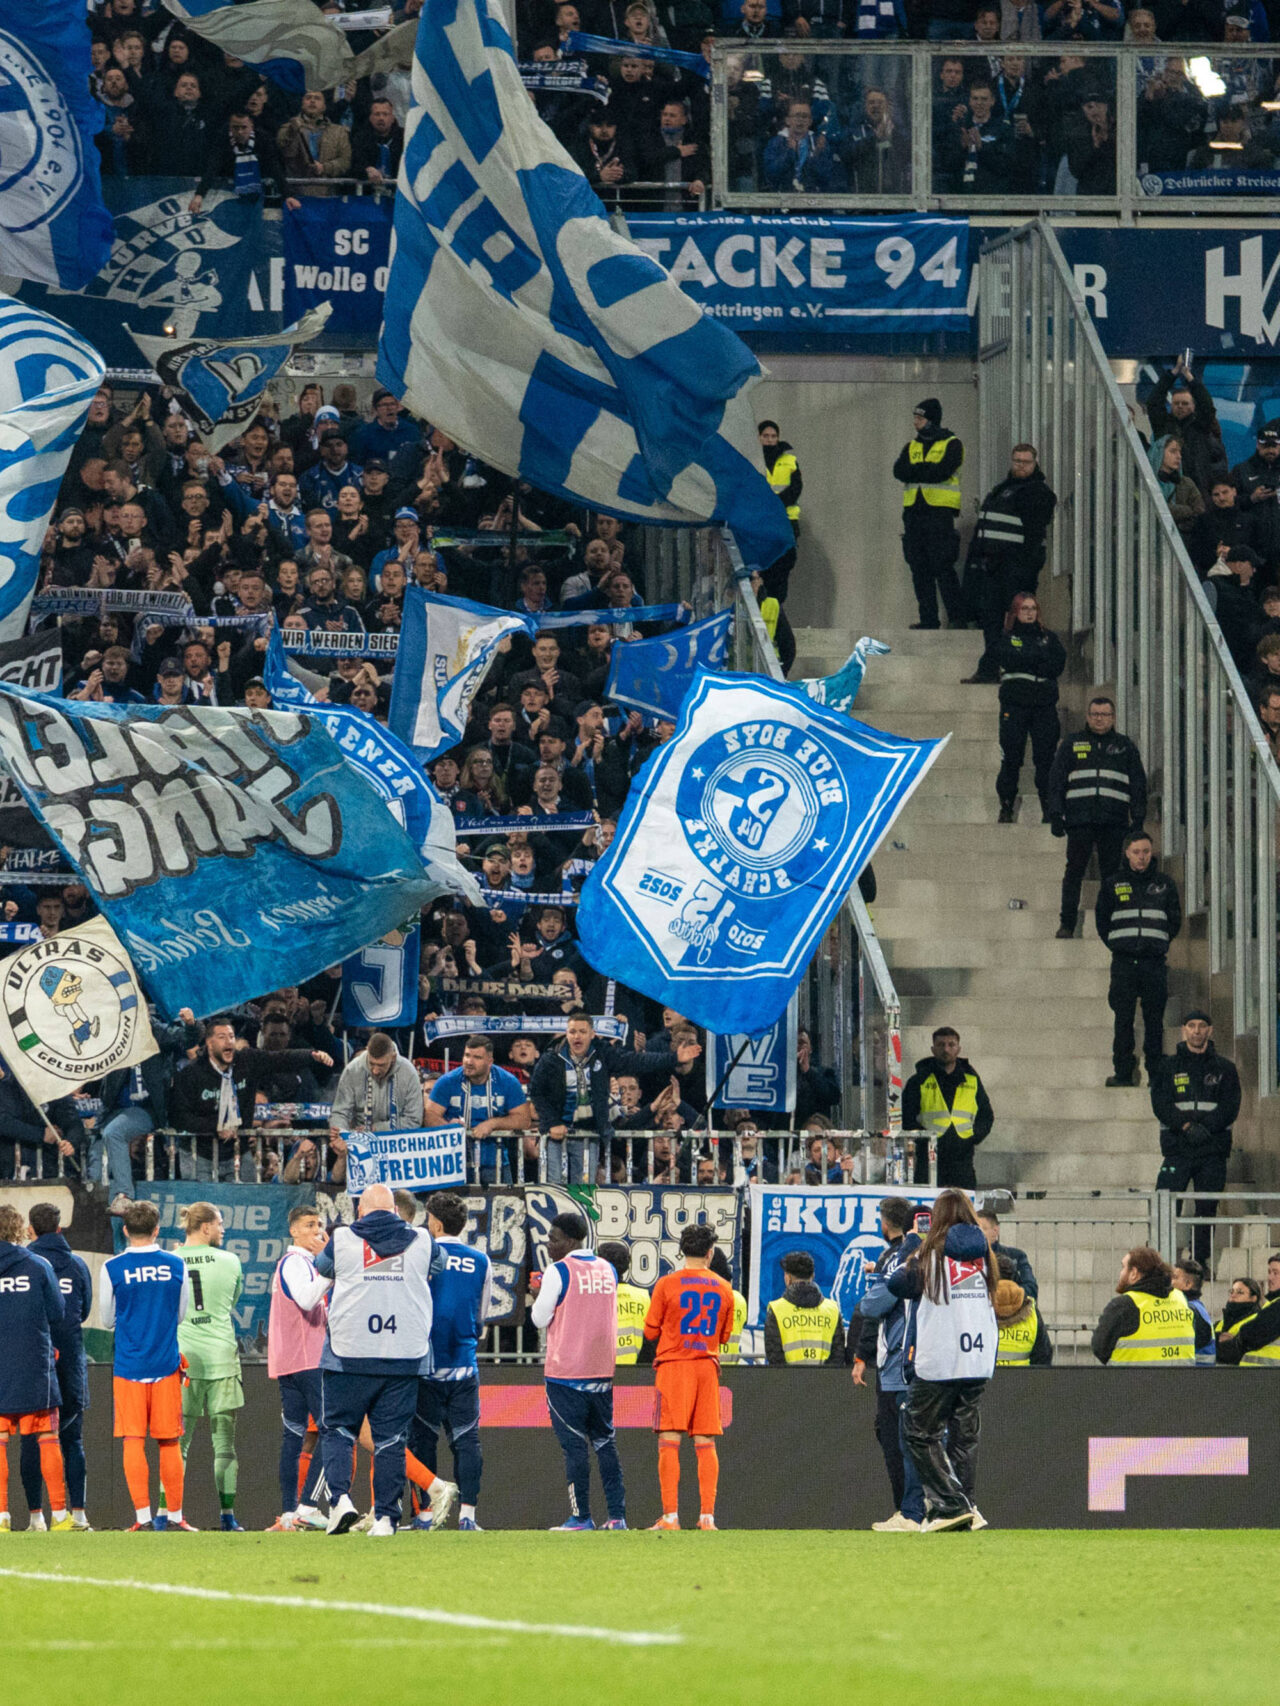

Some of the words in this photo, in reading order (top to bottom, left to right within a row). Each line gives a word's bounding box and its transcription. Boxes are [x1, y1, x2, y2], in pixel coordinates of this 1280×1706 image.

[751, 214, 832, 228] Fan-Club
[333, 228, 370, 256] SC
[874, 236, 962, 290] 94
[294, 263, 367, 293] Wolle
[789, 303, 824, 318] e.V.
[280, 629, 305, 646] WIR
[310, 630, 364, 649] WERDEN
[369, 632, 400, 651] SIEG
[13, 924, 45, 943] 04
[8, 941, 105, 990] ULTRAS
[369, 1131, 464, 1154] DURCHHALTEN
[378, 1151, 464, 1183] FREUNDE
[595, 1189, 738, 1240] BLUE
[767, 1196, 783, 1232] Die
[205, 1254, 216, 1264] 04
[390, 1259, 403, 1272] 2
[445, 1256, 476, 1274] RS
[123, 1265, 173, 1285] HRS
[188, 1269, 205, 1311] 1
[579, 1278, 616, 1295] HRS
[951, 1292, 987, 1300] BUNDESLIGA
[679, 1290, 722, 1338] 23
[782, 1314, 832, 1330] ORDNER
[1142, 1309, 1194, 1326] ORDNER
[367, 1314, 398, 1335] 04
[959, 1332, 985, 1353] 04
[1160, 1346, 1181, 1359] 304
[802, 1348, 817, 1360] 48
